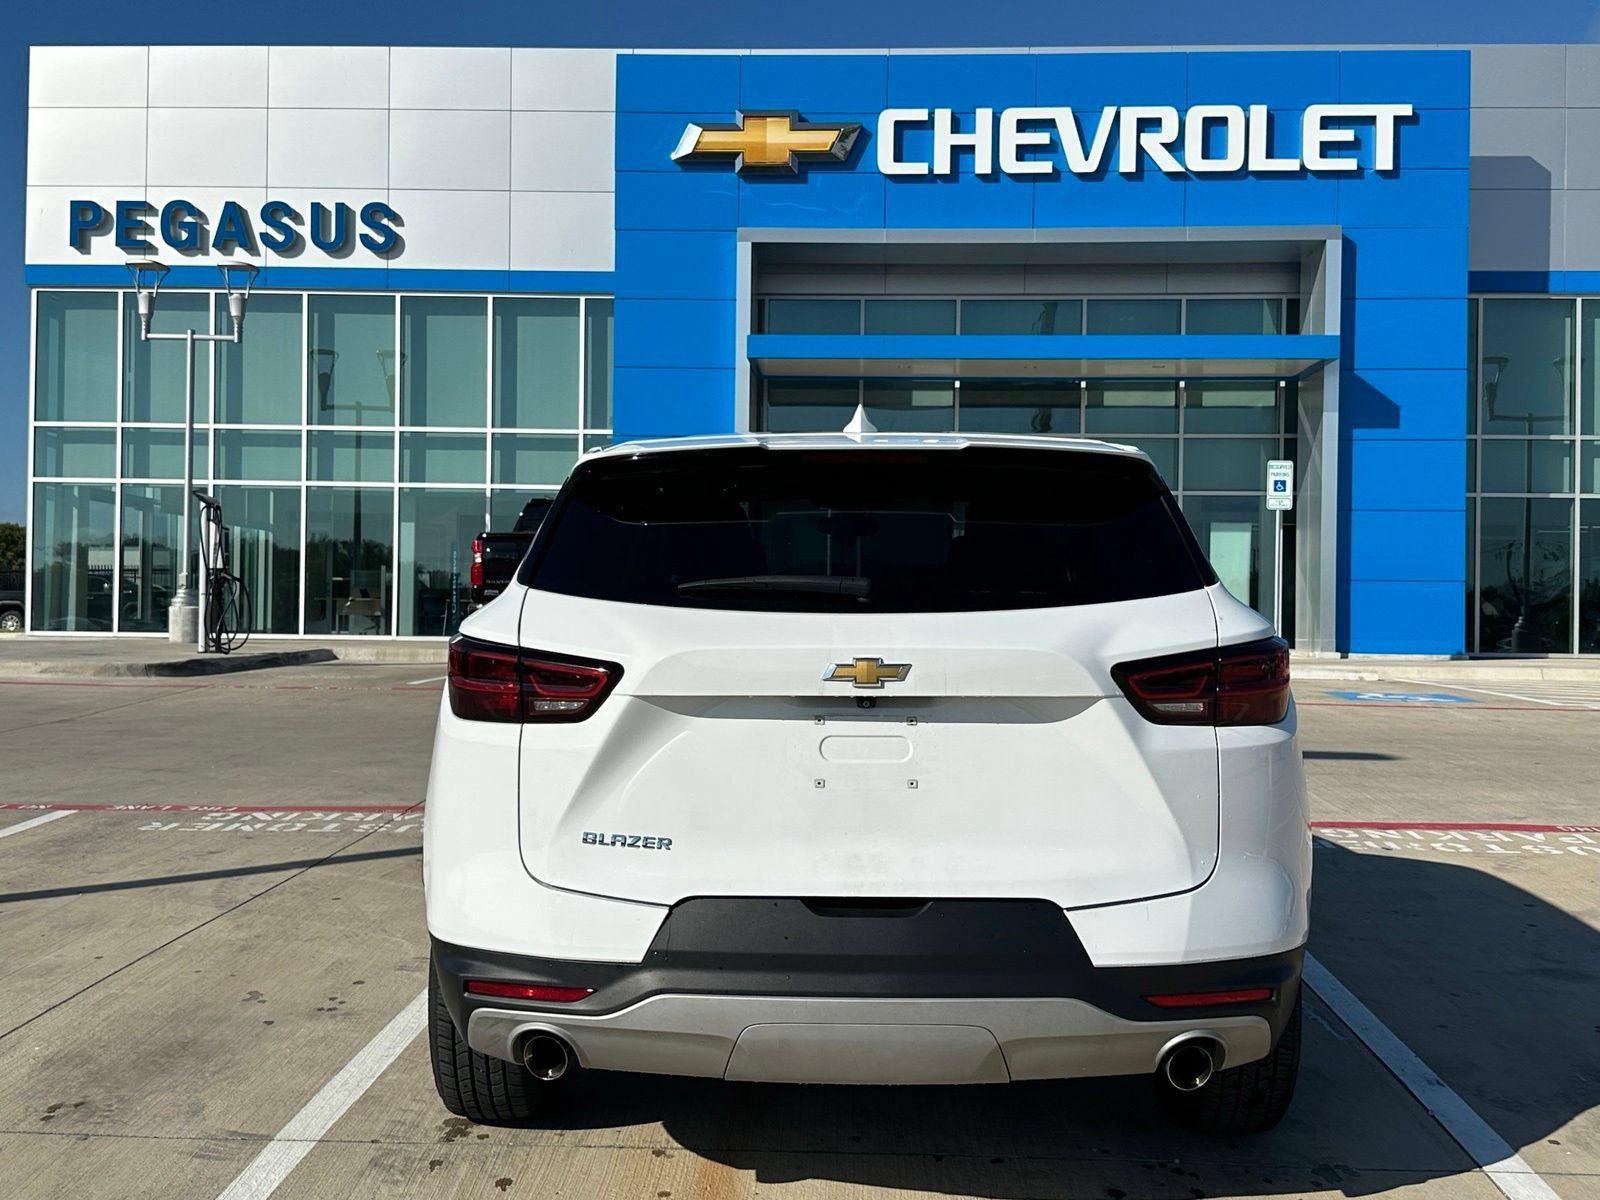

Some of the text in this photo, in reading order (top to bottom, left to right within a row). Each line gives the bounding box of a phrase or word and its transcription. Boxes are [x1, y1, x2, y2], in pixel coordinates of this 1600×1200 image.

[876, 103, 1414, 176] CHEVROLET
[69, 199, 399, 253] PEGASUS
[201, 812, 424, 821] ARKING
[138, 821, 424, 833] USTOMER
[582, 831, 673, 850] BLAZER
[1320, 829, 1597, 844] PARKING
